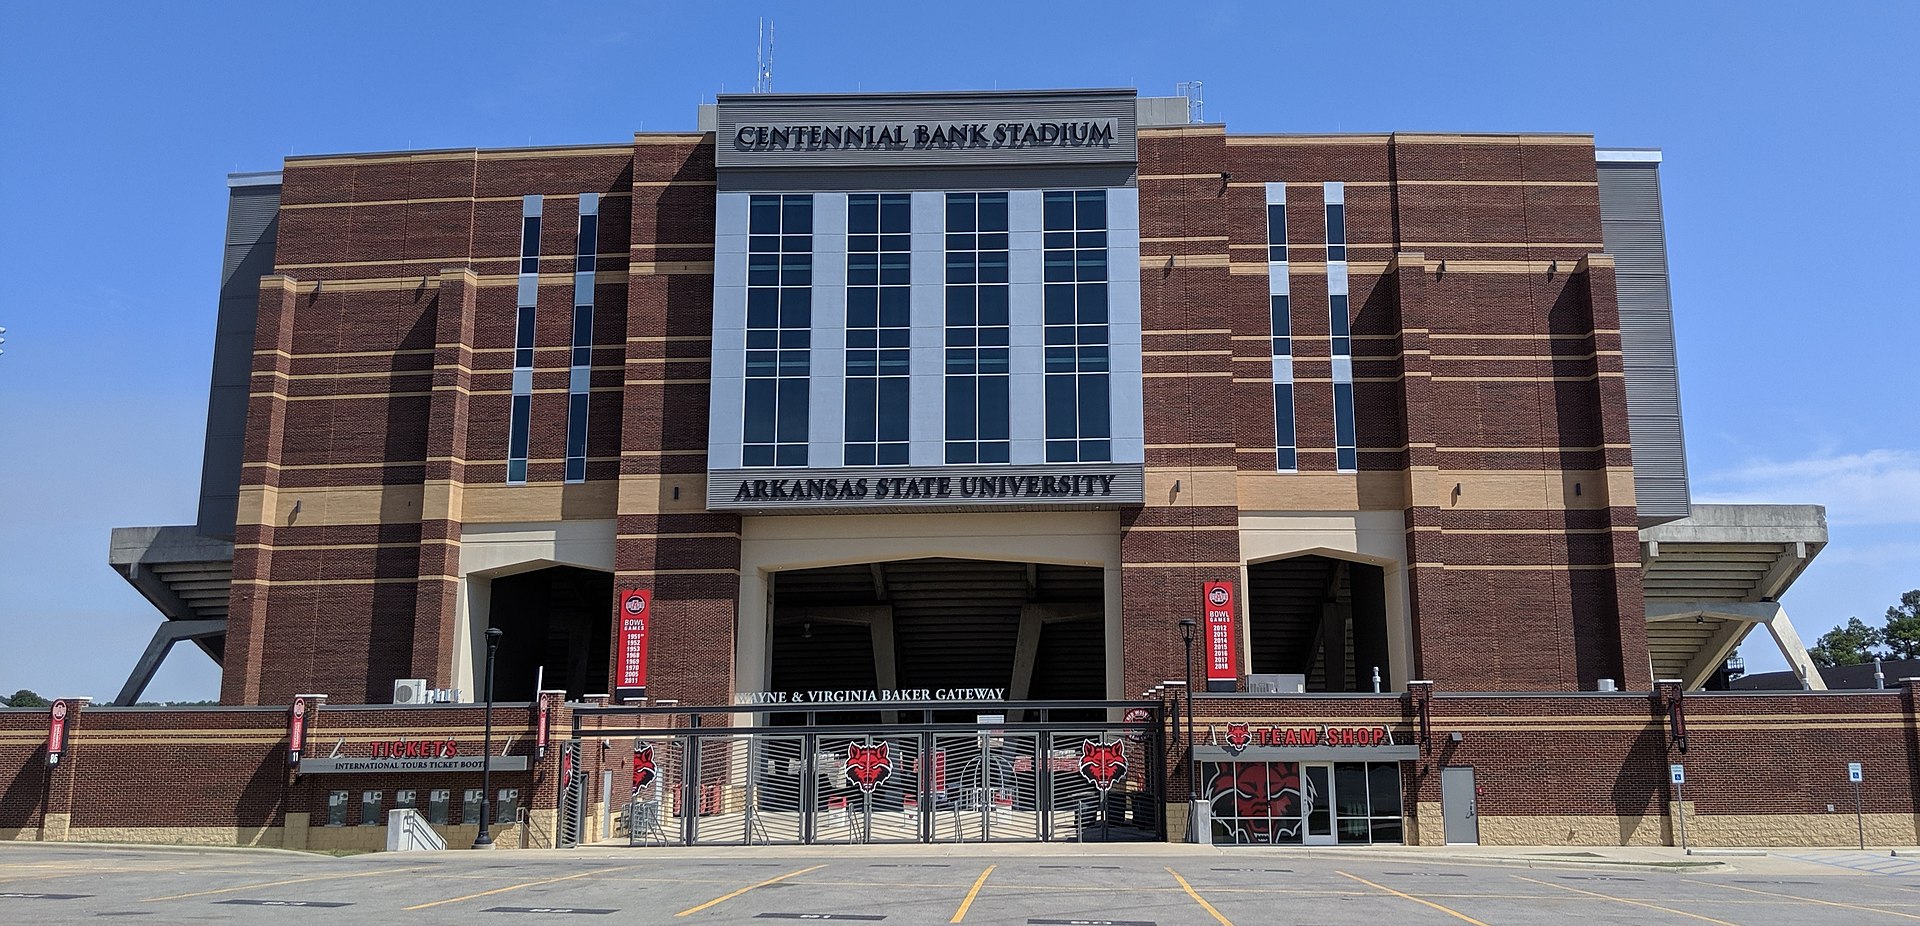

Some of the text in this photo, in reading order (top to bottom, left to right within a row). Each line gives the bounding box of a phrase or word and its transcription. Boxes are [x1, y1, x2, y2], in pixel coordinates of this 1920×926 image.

[736, 121, 1114, 149] CENTENNIAL BANK STADIUM
[735, 474, 1116, 501] ARKANSAS STATE UNIVERSITY
[736, 688, 1005, 704] WAYNE & VIRGINIA BAKER GATEWAY
[1257, 728, 1385, 746] TEAM SHOP
[371, 740, 457, 758] TICKETS
[335, 762, 399, 770] INTERNATIONAL
[430, 761, 459, 769] TICKET
